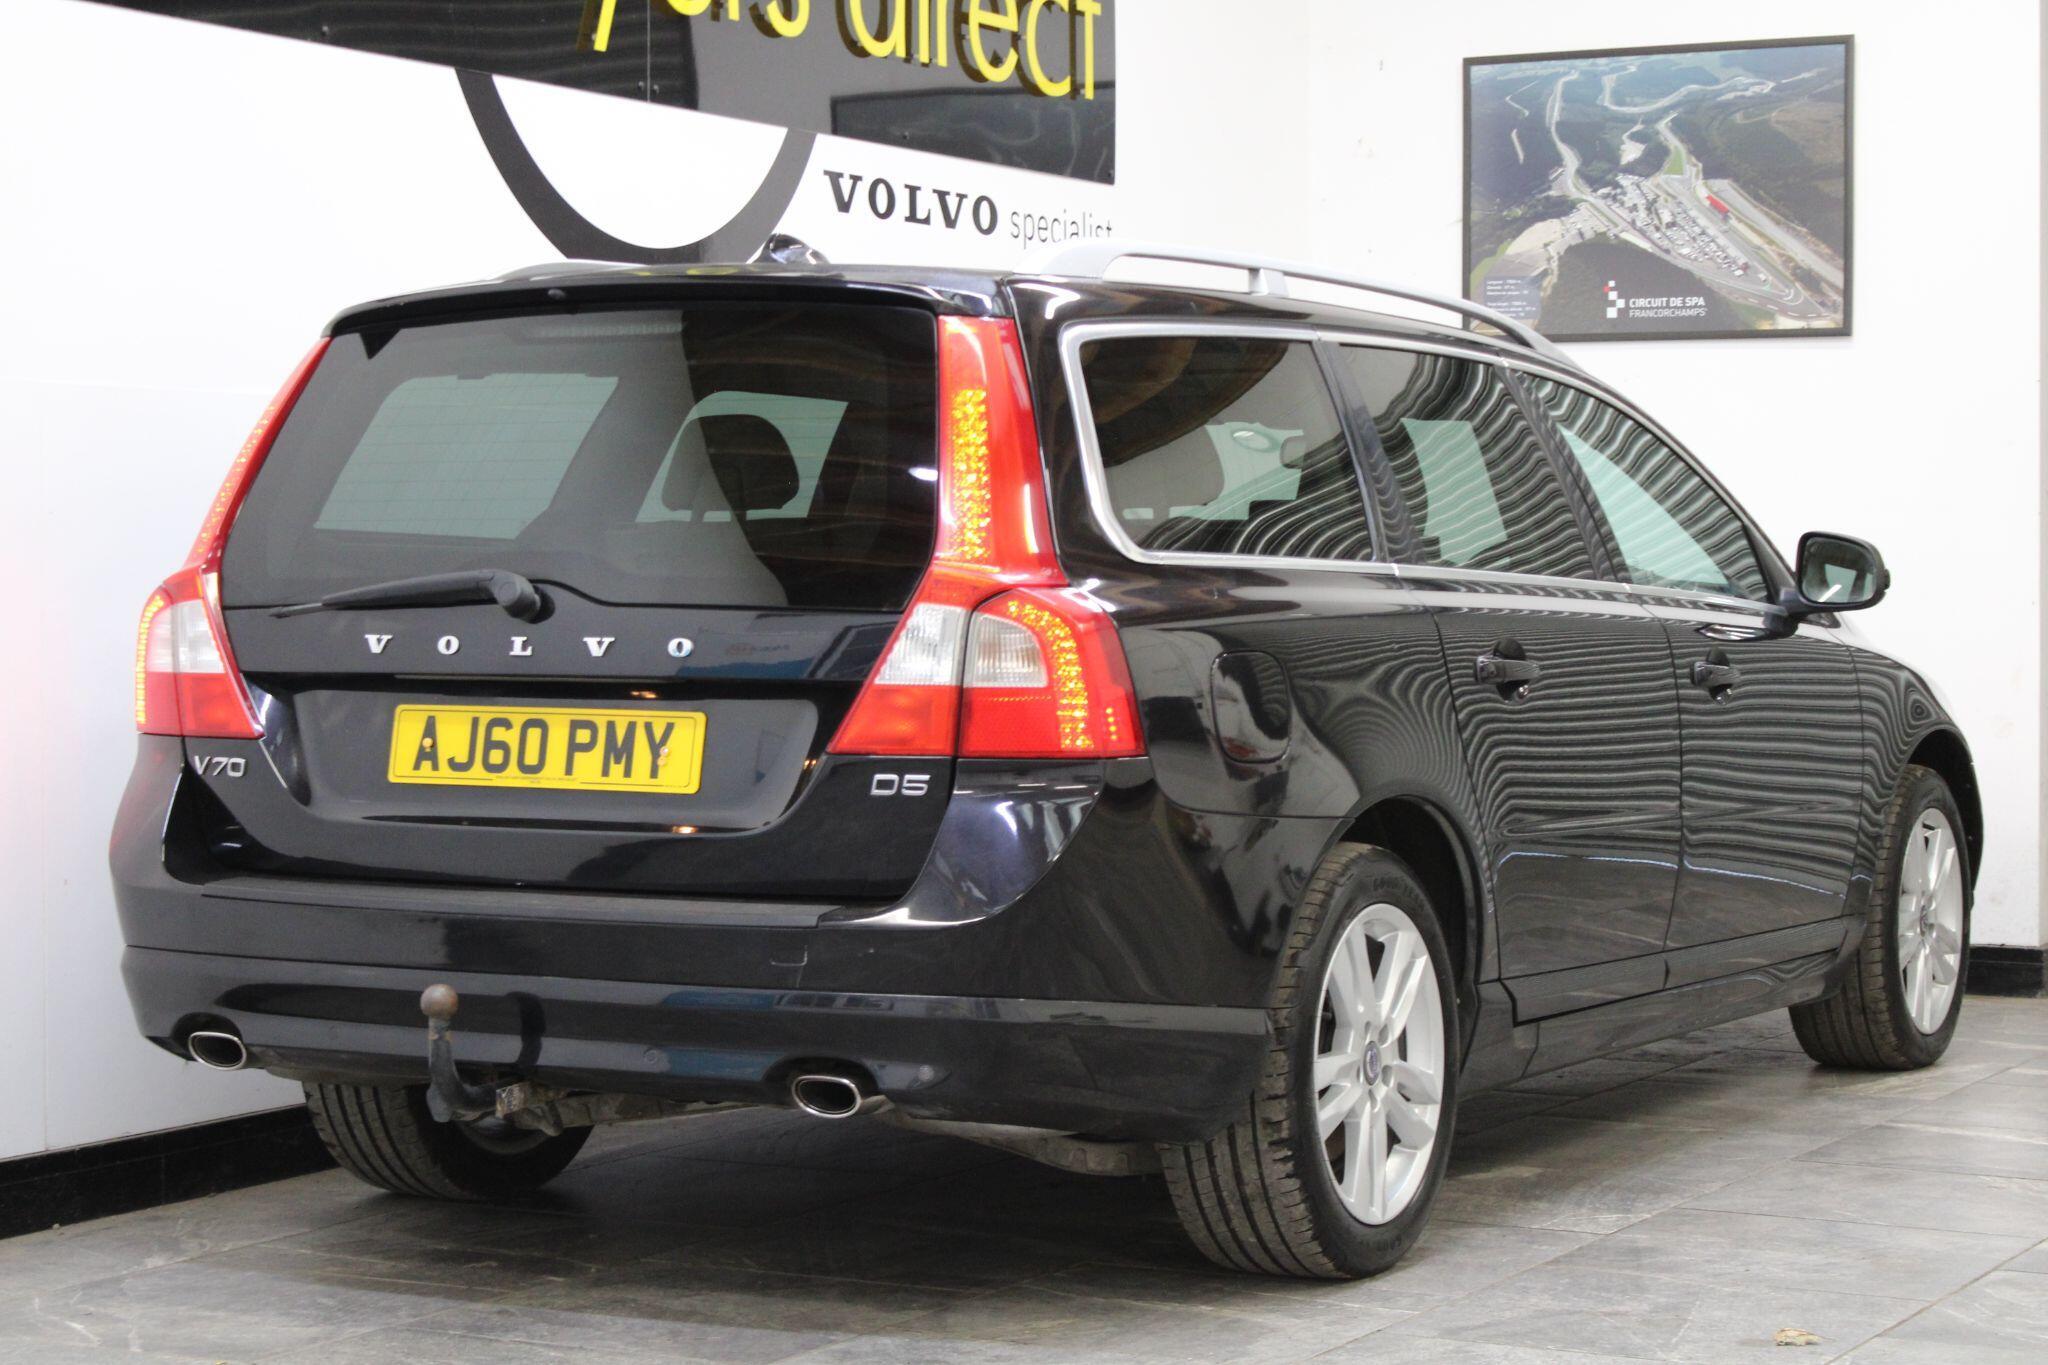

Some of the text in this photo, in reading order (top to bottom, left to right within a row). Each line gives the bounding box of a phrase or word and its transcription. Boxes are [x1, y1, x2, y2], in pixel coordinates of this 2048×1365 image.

[823, 169, 998, 236] VOLVO
[1629, 296, 1705, 308] CIRCUIT DE SPA
[1629, 307, 1706, 318] FRANCORCHAMPS
[364, 633, 694, 659] VOLVO
[412, 714, 675, 780] AJ60 PMY
[194, 755, 246, 778] V70
[870, 773, 931, 797] D5
